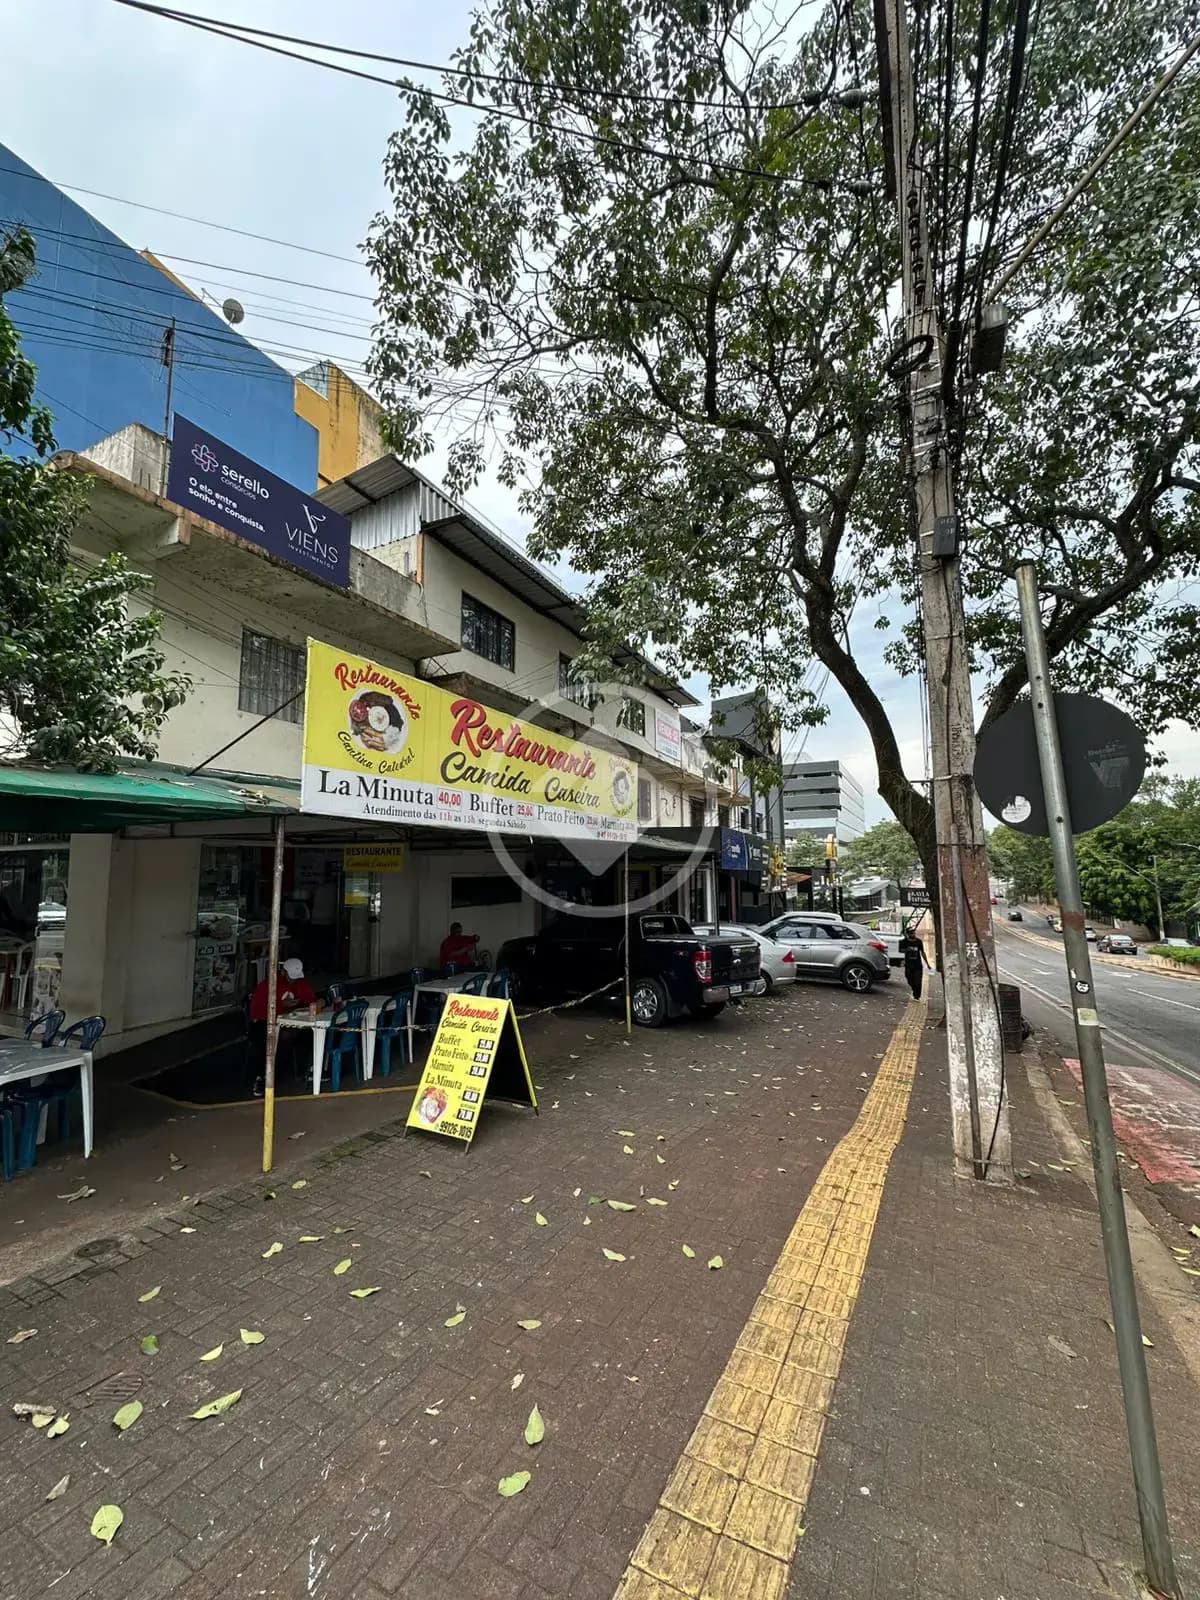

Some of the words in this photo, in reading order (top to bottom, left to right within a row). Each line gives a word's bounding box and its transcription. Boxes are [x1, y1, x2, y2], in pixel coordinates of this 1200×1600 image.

[188, 487, 216, 506] sonho
[189, 477, 198, 487] O
[199, 484, 213, 496] elo
[214, 492, 238, 509] entre
[221, 464, 269, 499] serello
[285, 522, 338, 563] VIENS
[334, 662, 422, 720] Restaurante
[450, 698, 596, 780] Restaurante
[318, 770, 351, 796] La
[357, 776, 433, 806] Minuta
[438, 791, 461, 808] 40,00
[470, 793, 514, 816] Buffet
[537, 805, 563, 822] Prato
[564, 810, 585, 826] Feito
[544, 776, 601, 808] Caseira
[363, 802, 422, 818] Atendimento
[423, 809, 437, 819] das
[448, 1000, 499, 1021] Restaurante
[434, 1045, 452, 1058] Prato
[452, 1047, 469, 1061] Feito
[438, 1033, 461, 1047] Buffet
[425, 1072, 435, 1085] La
[436, 1074, 463, 1090] Minuta
